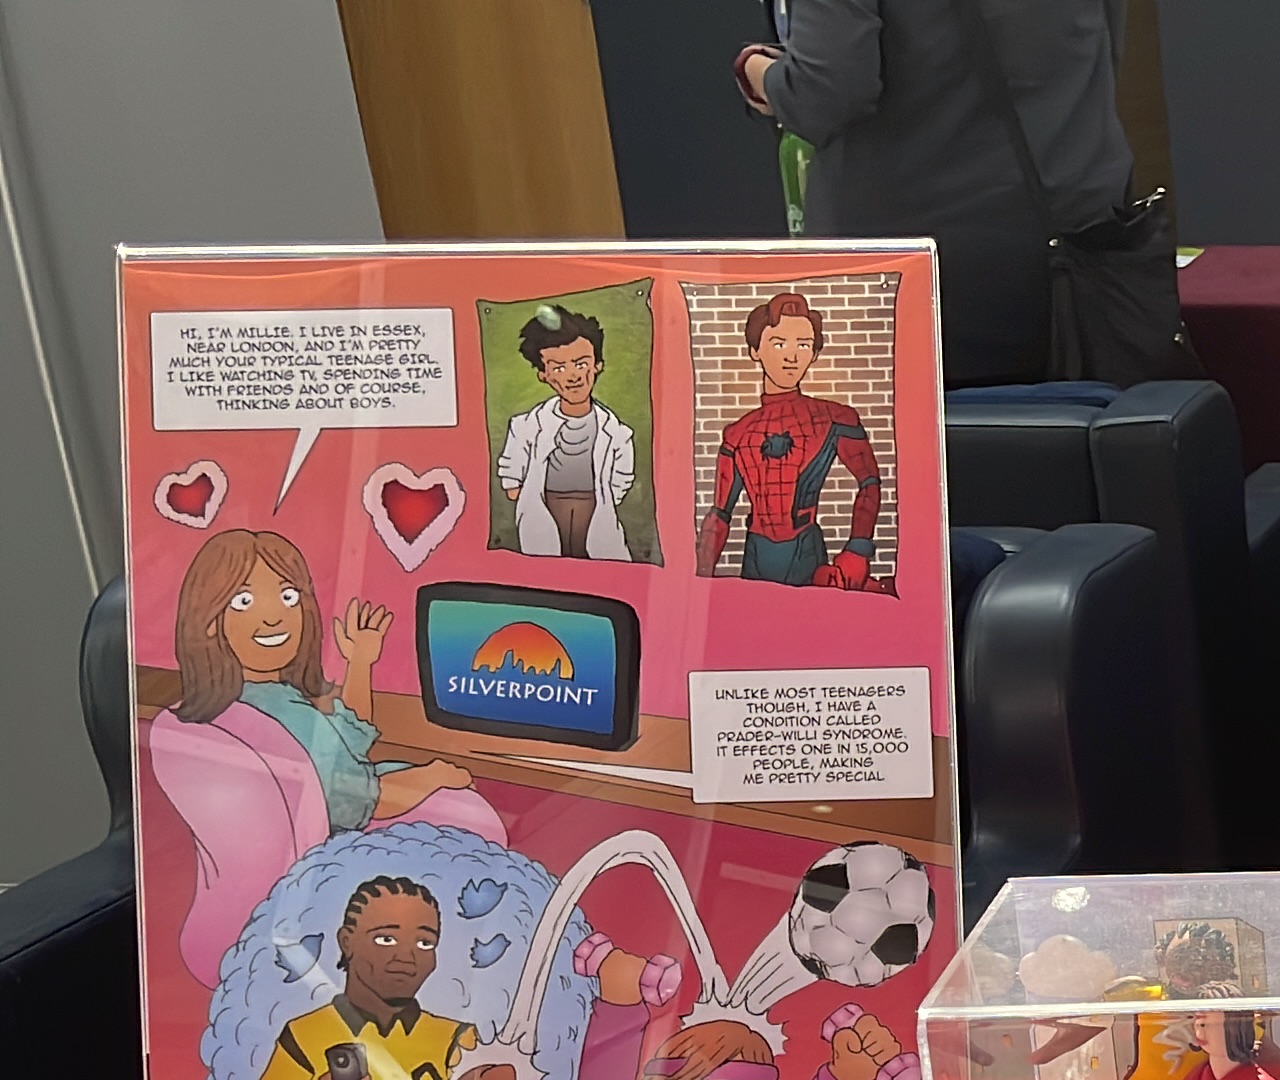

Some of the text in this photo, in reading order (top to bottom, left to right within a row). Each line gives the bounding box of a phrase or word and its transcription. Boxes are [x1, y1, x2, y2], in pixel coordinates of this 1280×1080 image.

[208, 327, 233, 339] I'M
[300, 326, 307, 338] I
[312, 326, 345, 338] LIVE
[350, 325, 367, 337] IN
[187, 342, 226, 354] NEAR
[304, 340, 335, 352] AND
[339, 339, 364, 352] I'M
[368, 339, 421, 351] PRETTY
[169, 356, 210, 368] MUCH
[216, 356, 256, 368] YOUR
[261, 355, 323, 367] TYPICAL
[326, 353, 394, 366] TEENAGE
[167, 371, 174, 383] I
[180, 371, 215, 382] LIKE
[220, 369, 295, 382] WATCHING
[323, 368, 402, 380] SPENDING
[406, 367, 442, 379] TIME
[184, 385, 222, 396] WITH
[227, 384, 294, 396] FRIENDS
[299, 383, 330, 396] AND
[334, 383, 356, 395] OF
[216, 398, 290, 410] THINKING
[295, 397, 344, 409] ABOUT
[448, 676, 599, 706] SILVERPOINT
[716, 685, 906, 700] UNLIKE MOST TEENAGERS
[815, 701, 822, 712] I
[827, 700, 862, 712] HAVE
[866, 700, 876, 711] A
[743, 714, 881, 728] CONDITION CALLED
[718, 730, 817, 742] PRADER-WILLI
[717, 742, 908, 757] IT EFFECTS ONE IN 15,000
[819, 757, 874, 769] MAKING
[743, 771, 884, 784] ME PRETTY SPECIAL
